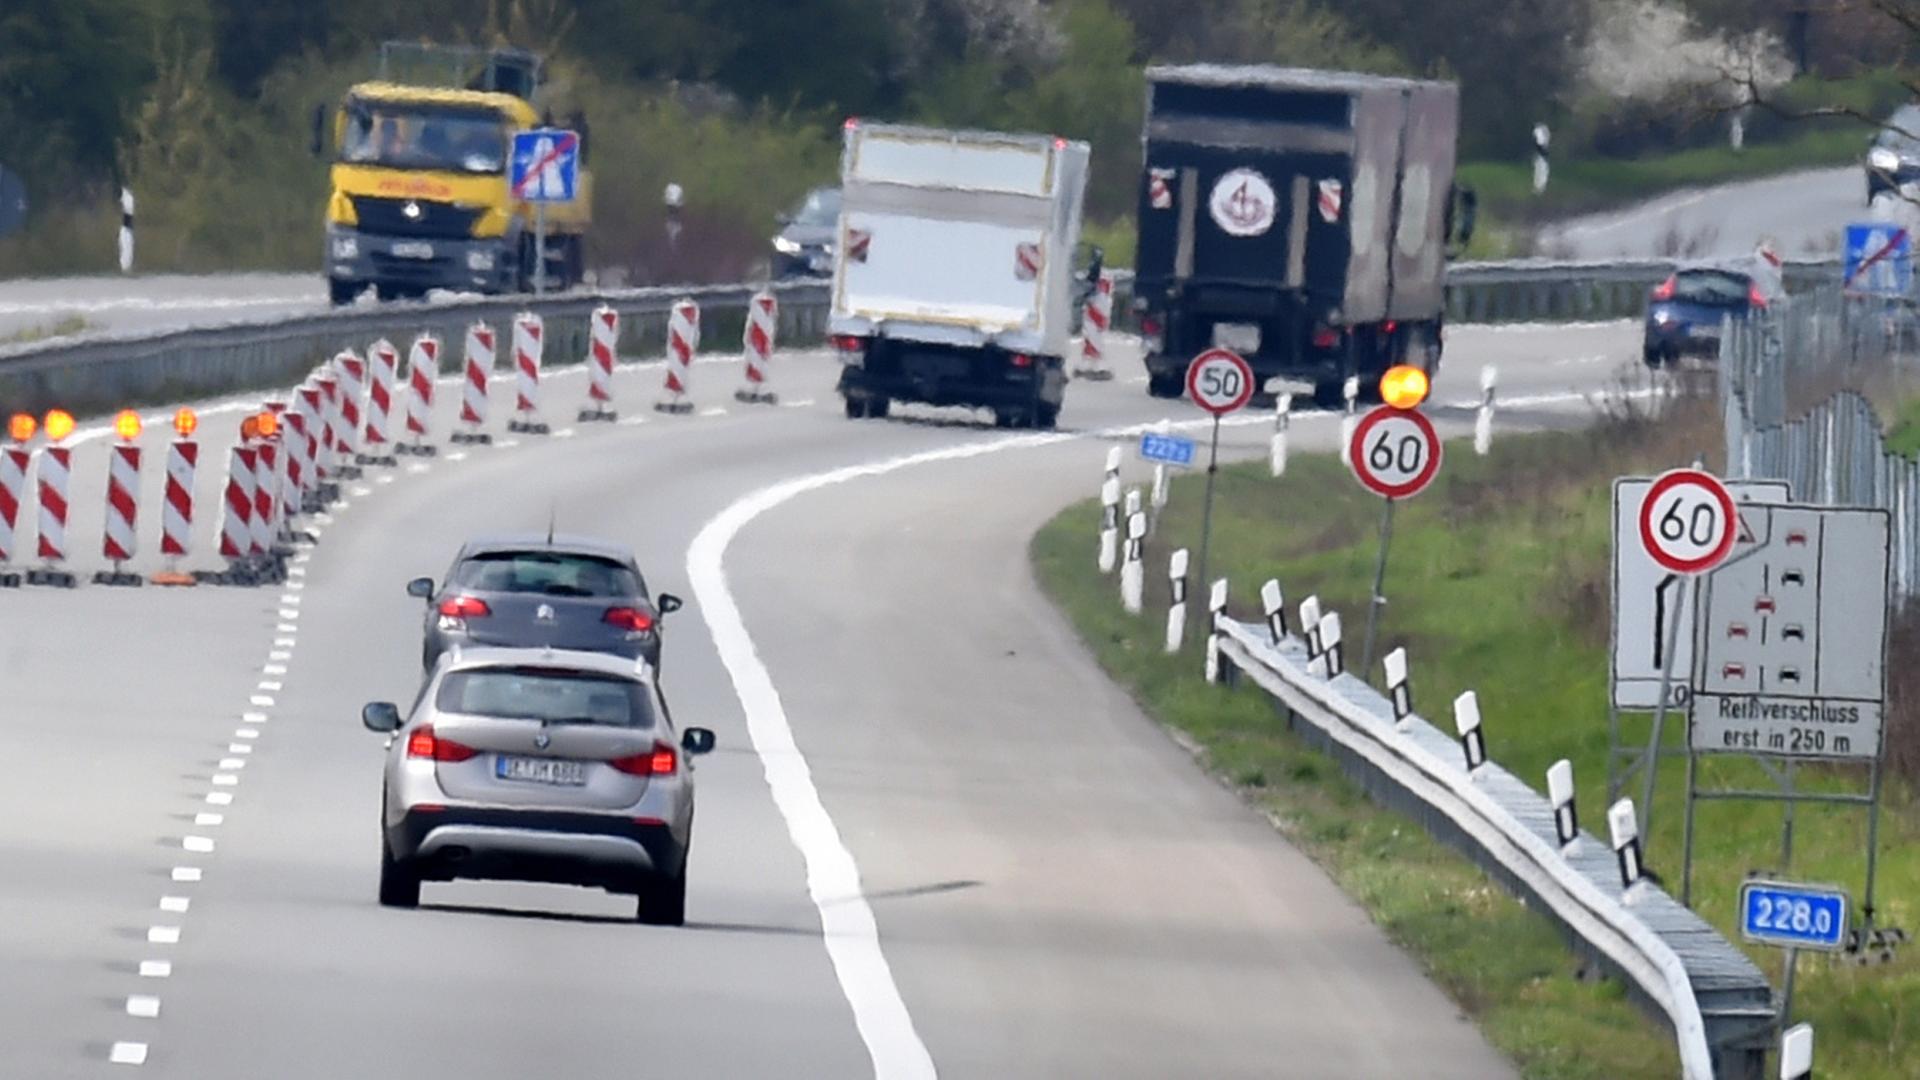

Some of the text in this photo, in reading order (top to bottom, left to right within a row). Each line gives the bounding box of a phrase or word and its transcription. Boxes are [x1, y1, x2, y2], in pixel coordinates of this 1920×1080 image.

[1203, 367, 1240, 397] 50
[1370, 430, 1421, 474] 60
[1660, 497, 1715, 546] 60
[1719, 697, 1860, 723] Reißverschluss
[1723, 727, 1850, 752] erst in 250 m
